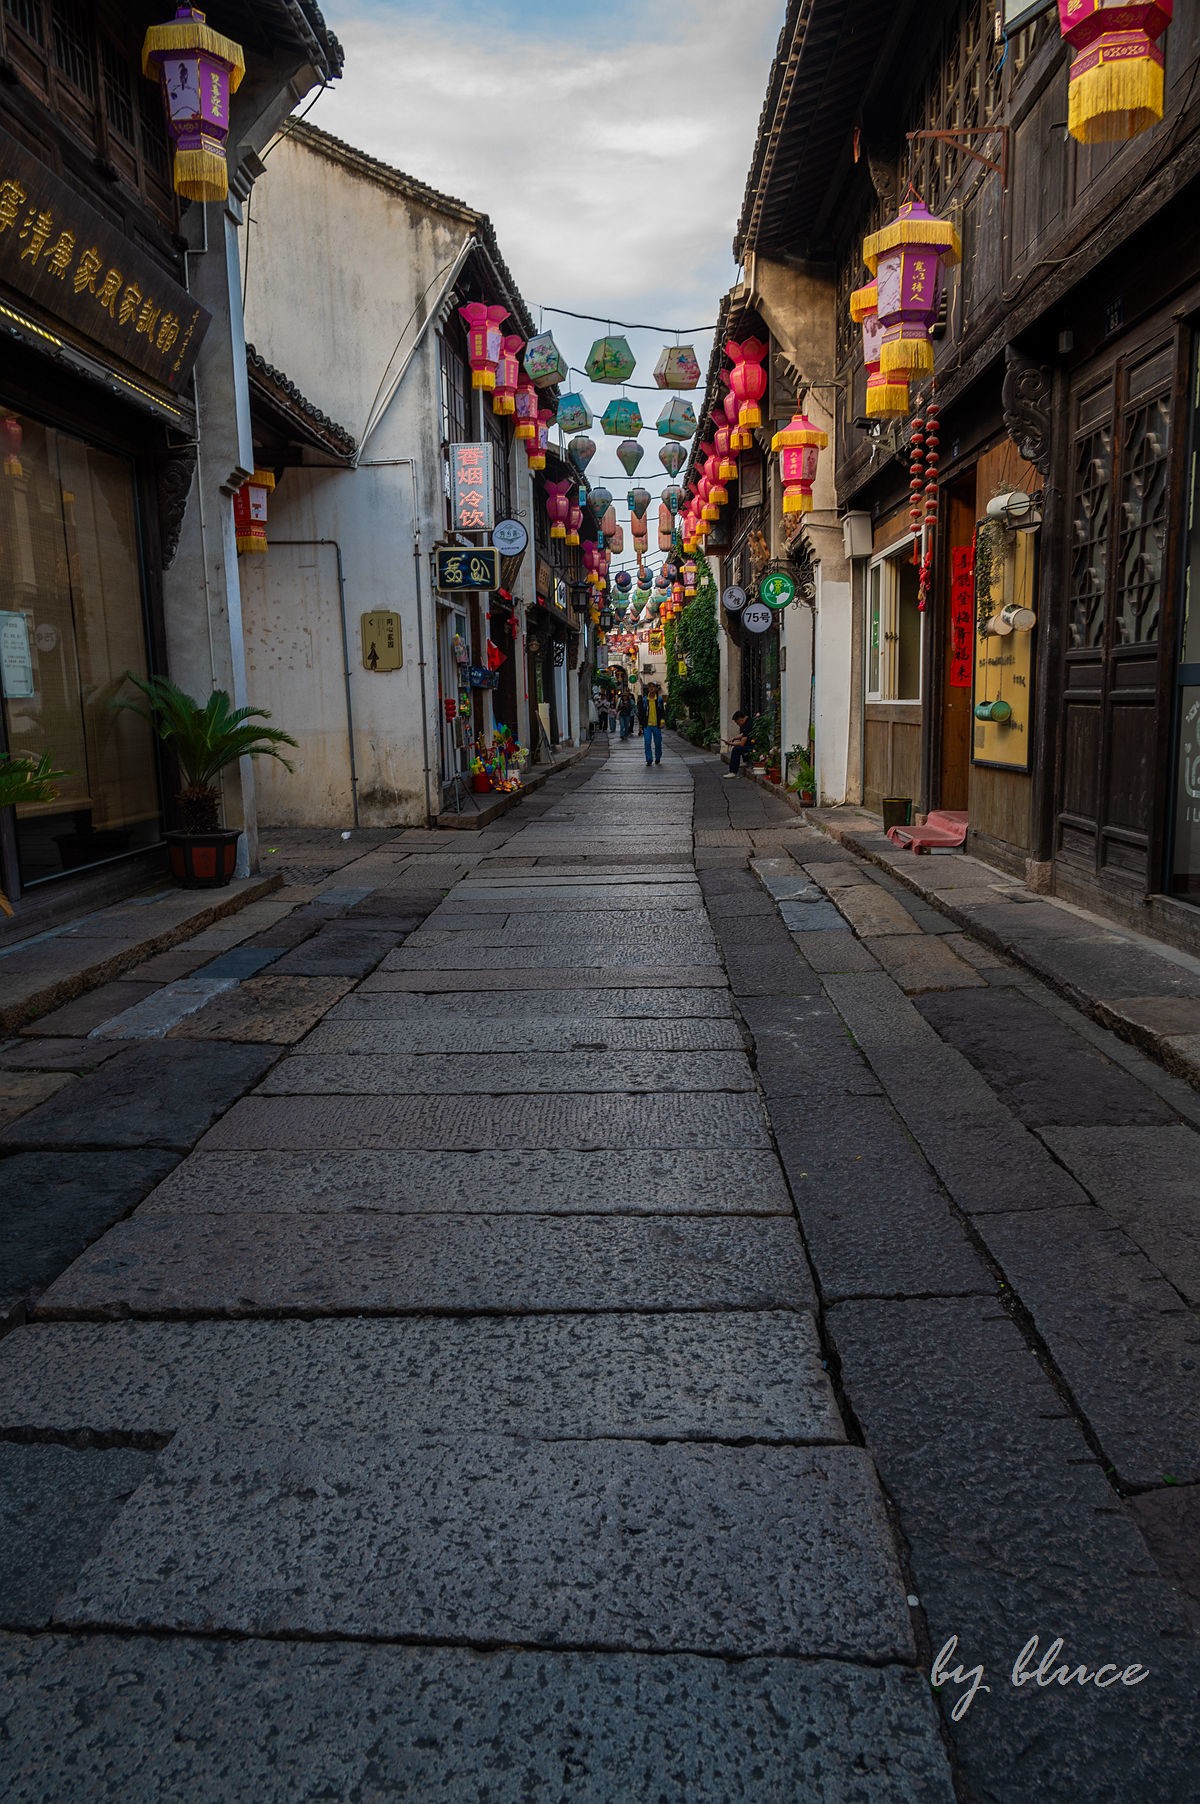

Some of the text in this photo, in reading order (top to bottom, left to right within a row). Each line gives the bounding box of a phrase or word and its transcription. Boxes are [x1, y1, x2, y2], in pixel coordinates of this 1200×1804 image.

[456, 446, 485, 528] 香烟冷饮
[745, 612, 771, 624] 75号
